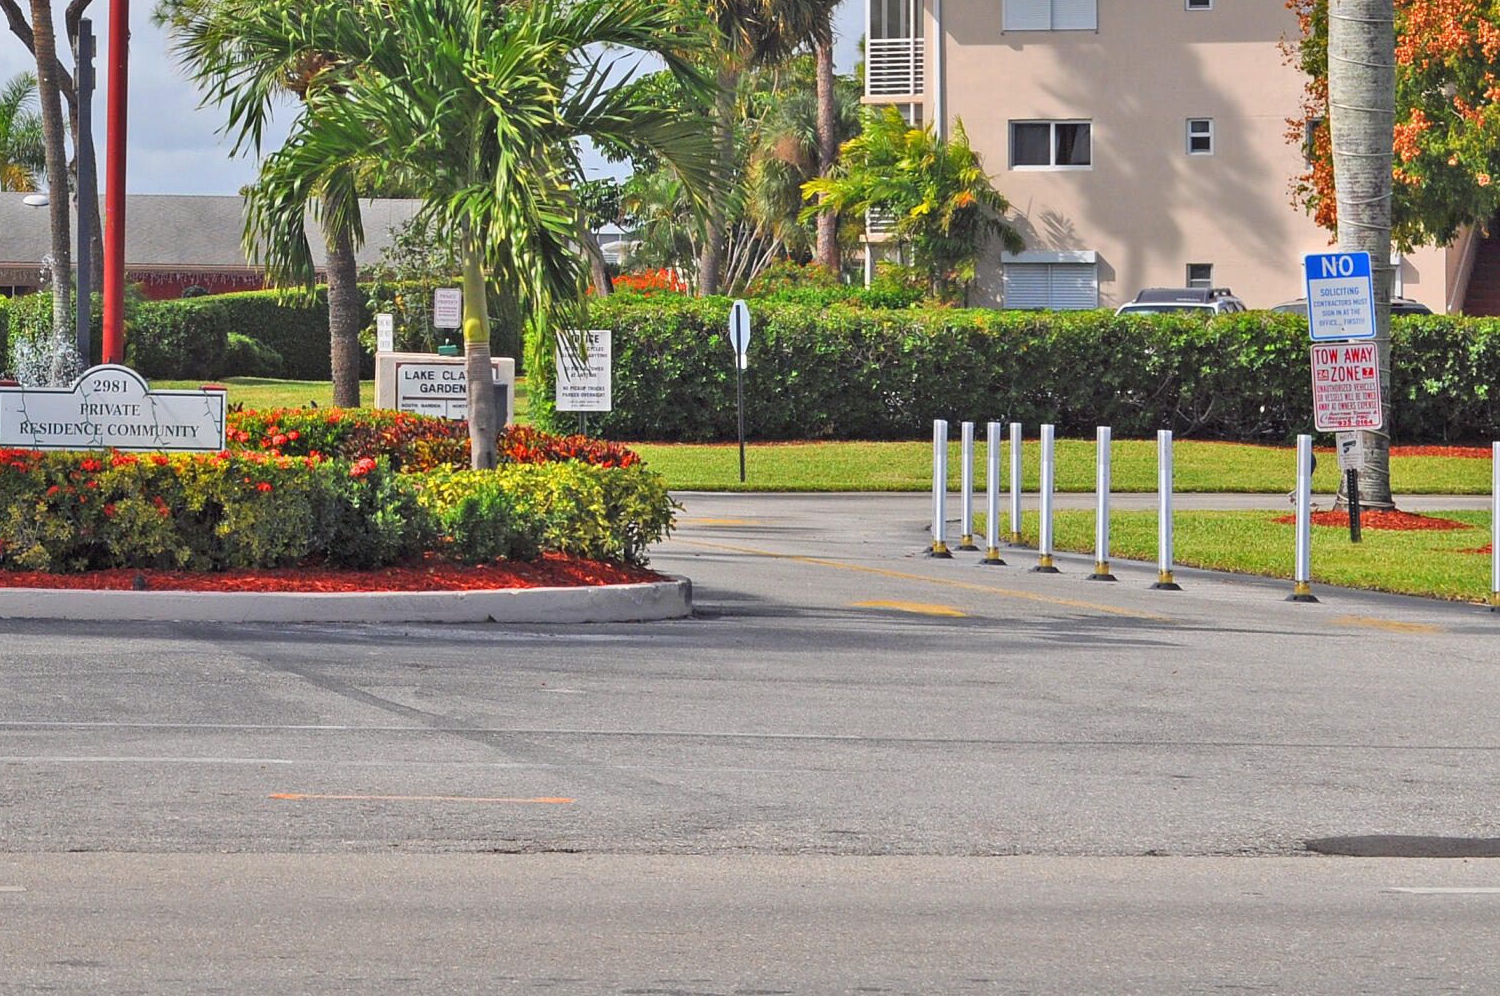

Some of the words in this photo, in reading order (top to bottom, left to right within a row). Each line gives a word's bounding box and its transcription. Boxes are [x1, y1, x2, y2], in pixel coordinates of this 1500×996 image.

[1321, 255, 1354, 277] NO
[1320, 287, 1359, 297] SOLICITING
[1315, 349, 1338, 365] TOW
[1344, 347, 1373, 363] AWAY
[405, 371, 435, 380] LAKE
[442, 371, 466, 380] CLA
[1331, 366, 1361, 382] ZONE
[93, 380, 127, 393] 2981
[420, 384, 466, 393] GARDEN
[1317, 384, 1352, 392] UNAUTHORIZED
[1353, 383, 1376, 391] VEHICLES
[1325, 393, 1343, 401] VESSELS
[1355, 392, 1361, 400] BE
[80, 404, 140, 415] PRIVATE
[1319, 403, 1329, 411] AWAY
[1357, 401, 1377, 409] EXPENSE
[19, 423, 103, 436] RESIDENCE
[107, 424, 200, 438] COMMUNITY
